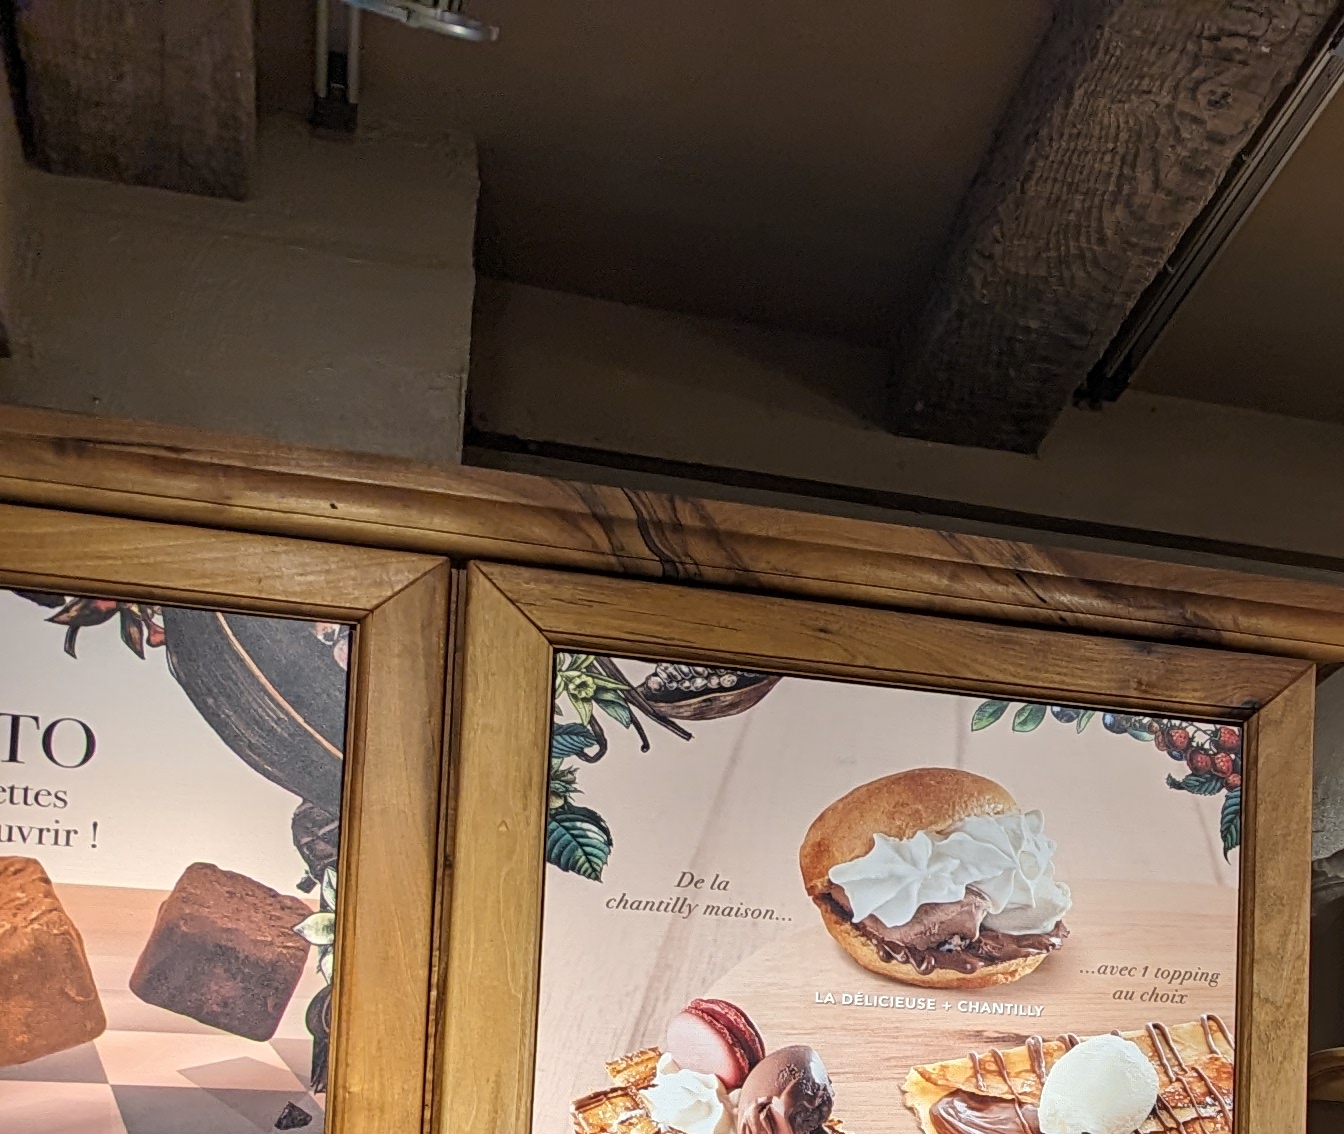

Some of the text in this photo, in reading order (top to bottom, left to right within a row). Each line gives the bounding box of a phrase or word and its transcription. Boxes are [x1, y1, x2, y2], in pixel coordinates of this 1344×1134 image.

[674, 871, 731, 892] De la
[605, 893, 793, 922] chantilly maison...
[1080, 963, 1139, 978] ...avec
[1155, 964, 1221, 987] topping
[814, 991, 836, 1005] LA
[842, 990, 936, 1012] DÉLICIEUSE
[957, 1000, 1045, 1018] CHANTILLY
[1112, 986, 1189, 1004] au choix
